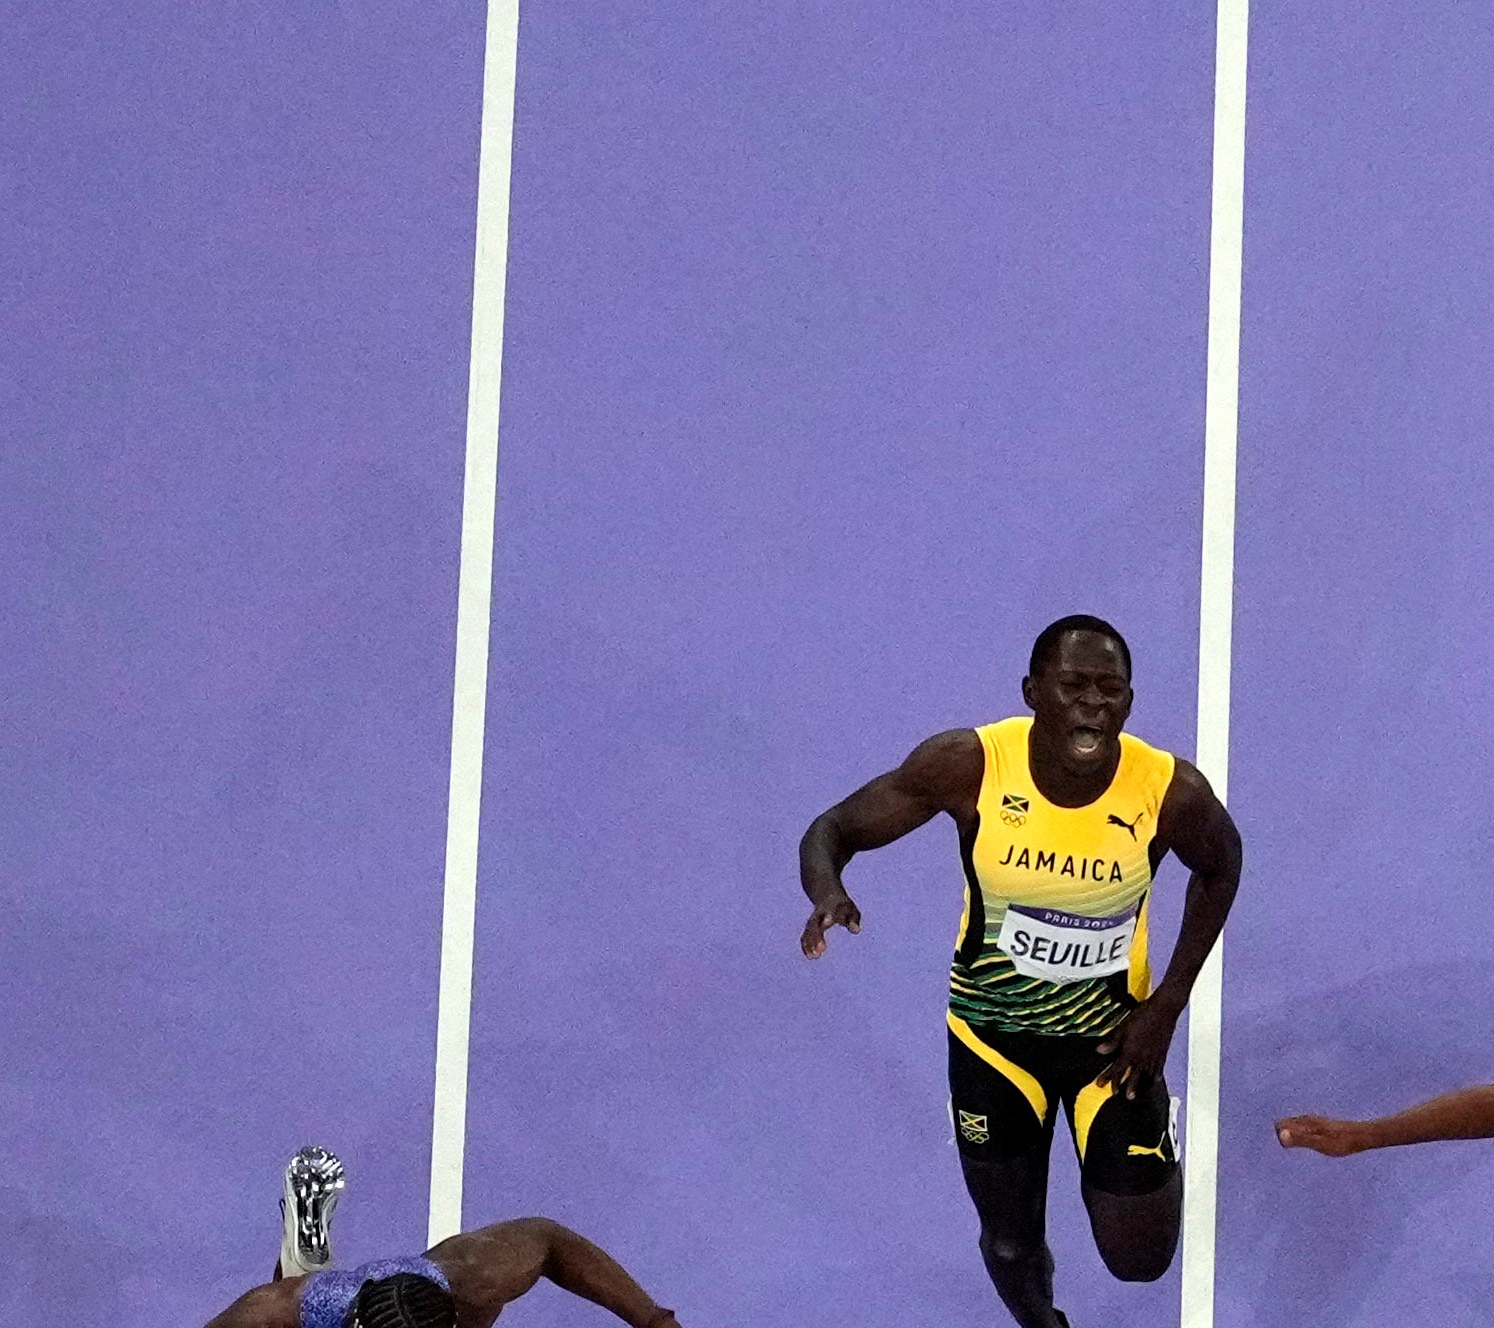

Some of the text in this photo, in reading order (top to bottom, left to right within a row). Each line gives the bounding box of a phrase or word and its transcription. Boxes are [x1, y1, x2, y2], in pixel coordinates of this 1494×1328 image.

[999, 844, 1123, 883] JAMAICA
[1044, 911, 1081, 927] PARIS
[1010, 930, 1126, 968] SEVILLE
